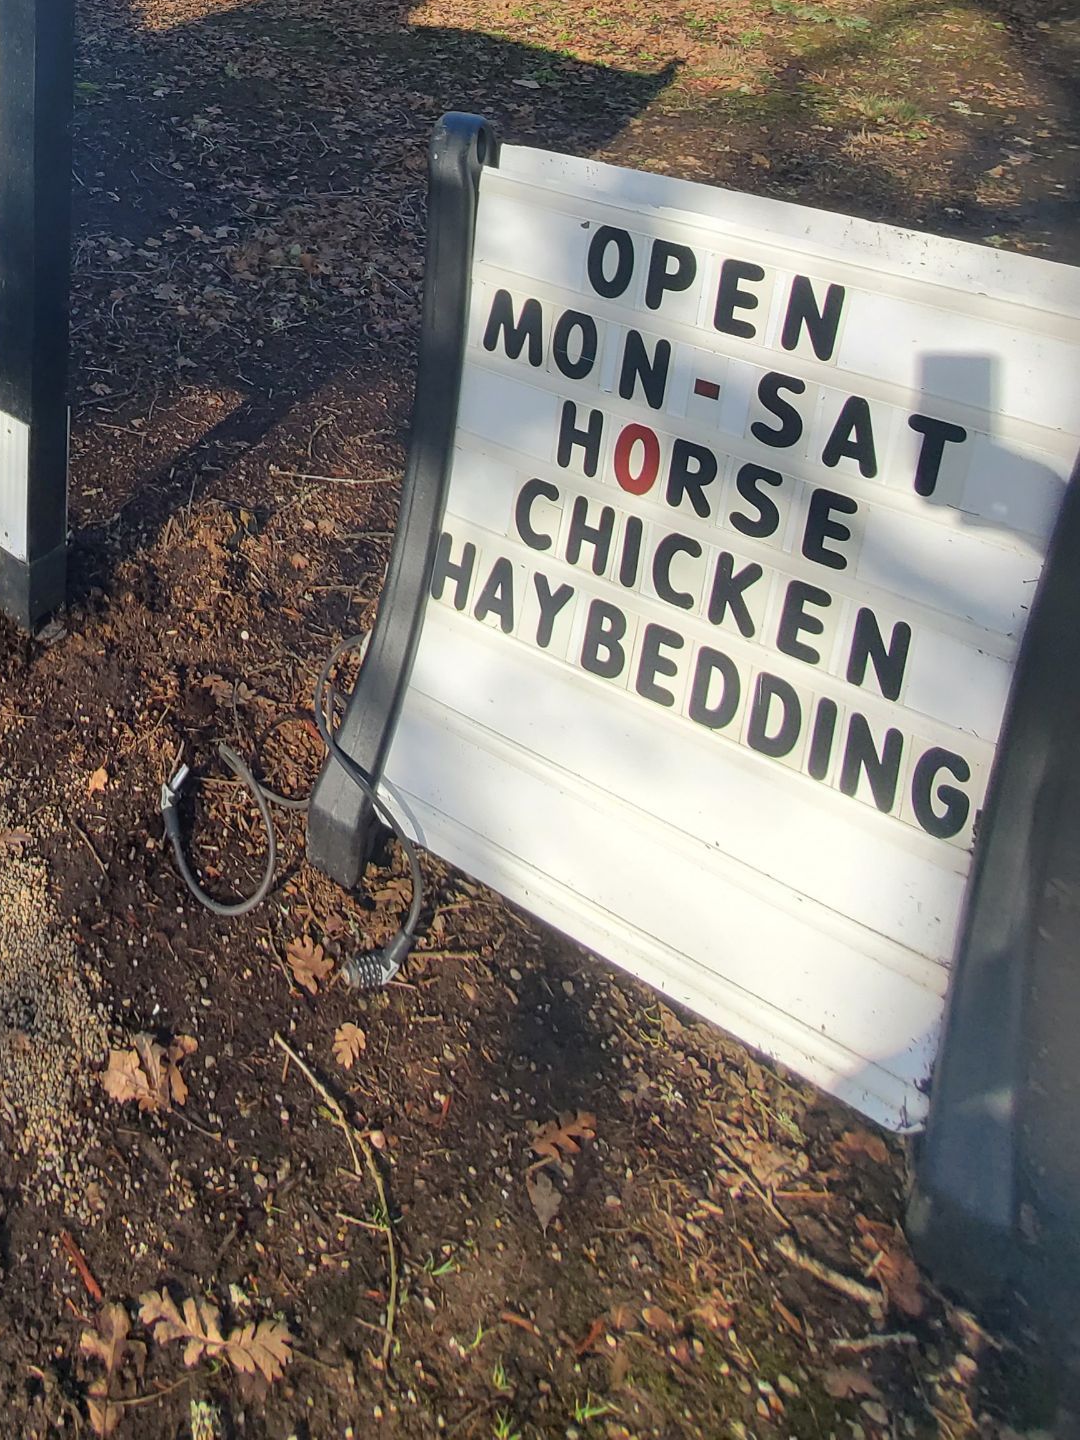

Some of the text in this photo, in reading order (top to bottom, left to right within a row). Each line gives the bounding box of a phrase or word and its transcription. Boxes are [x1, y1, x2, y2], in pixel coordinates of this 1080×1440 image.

[587, 225, 846, 361] OPEN
[557, 400, 857, 570] HORSE
[515, 478, 912, 703] CHICKEN
